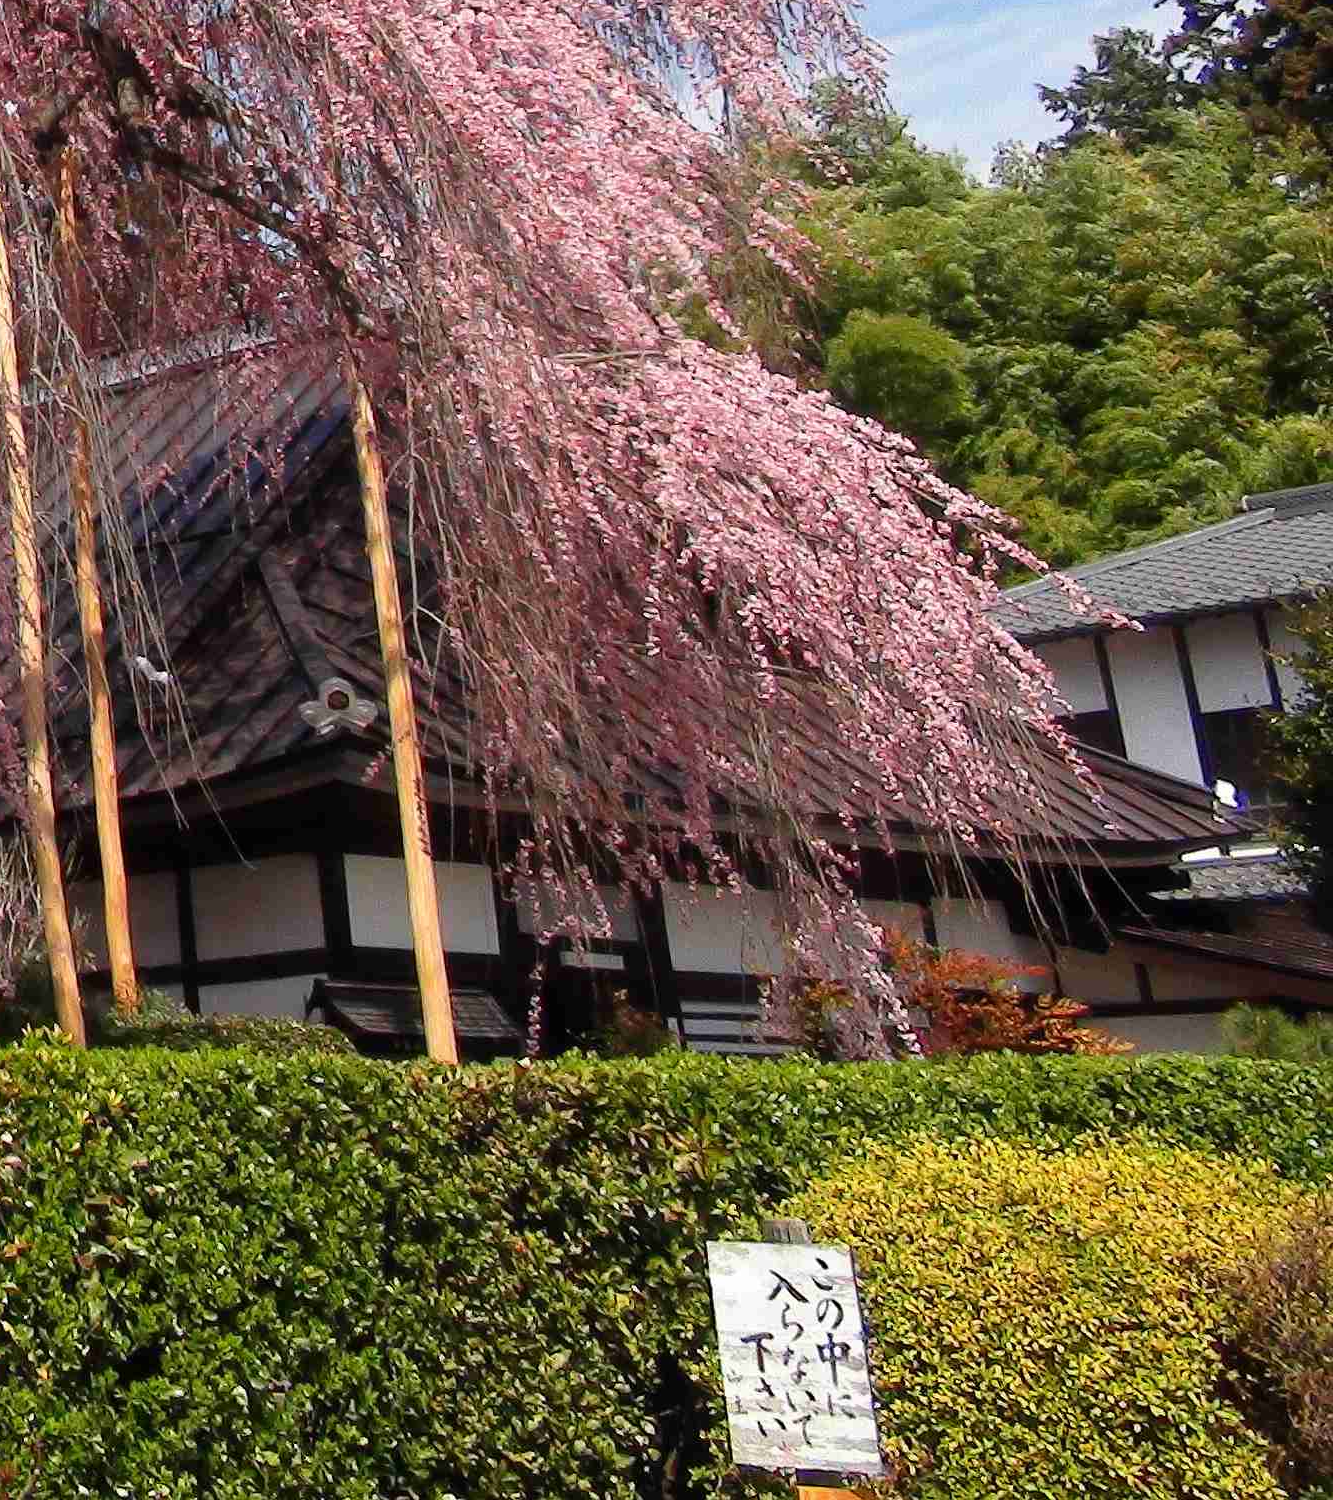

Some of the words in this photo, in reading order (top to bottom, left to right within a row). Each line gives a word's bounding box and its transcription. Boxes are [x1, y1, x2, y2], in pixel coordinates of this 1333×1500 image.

[741, 1332, 788, 1437] 下さい
[813, 1257, 856, 1419] この中に
